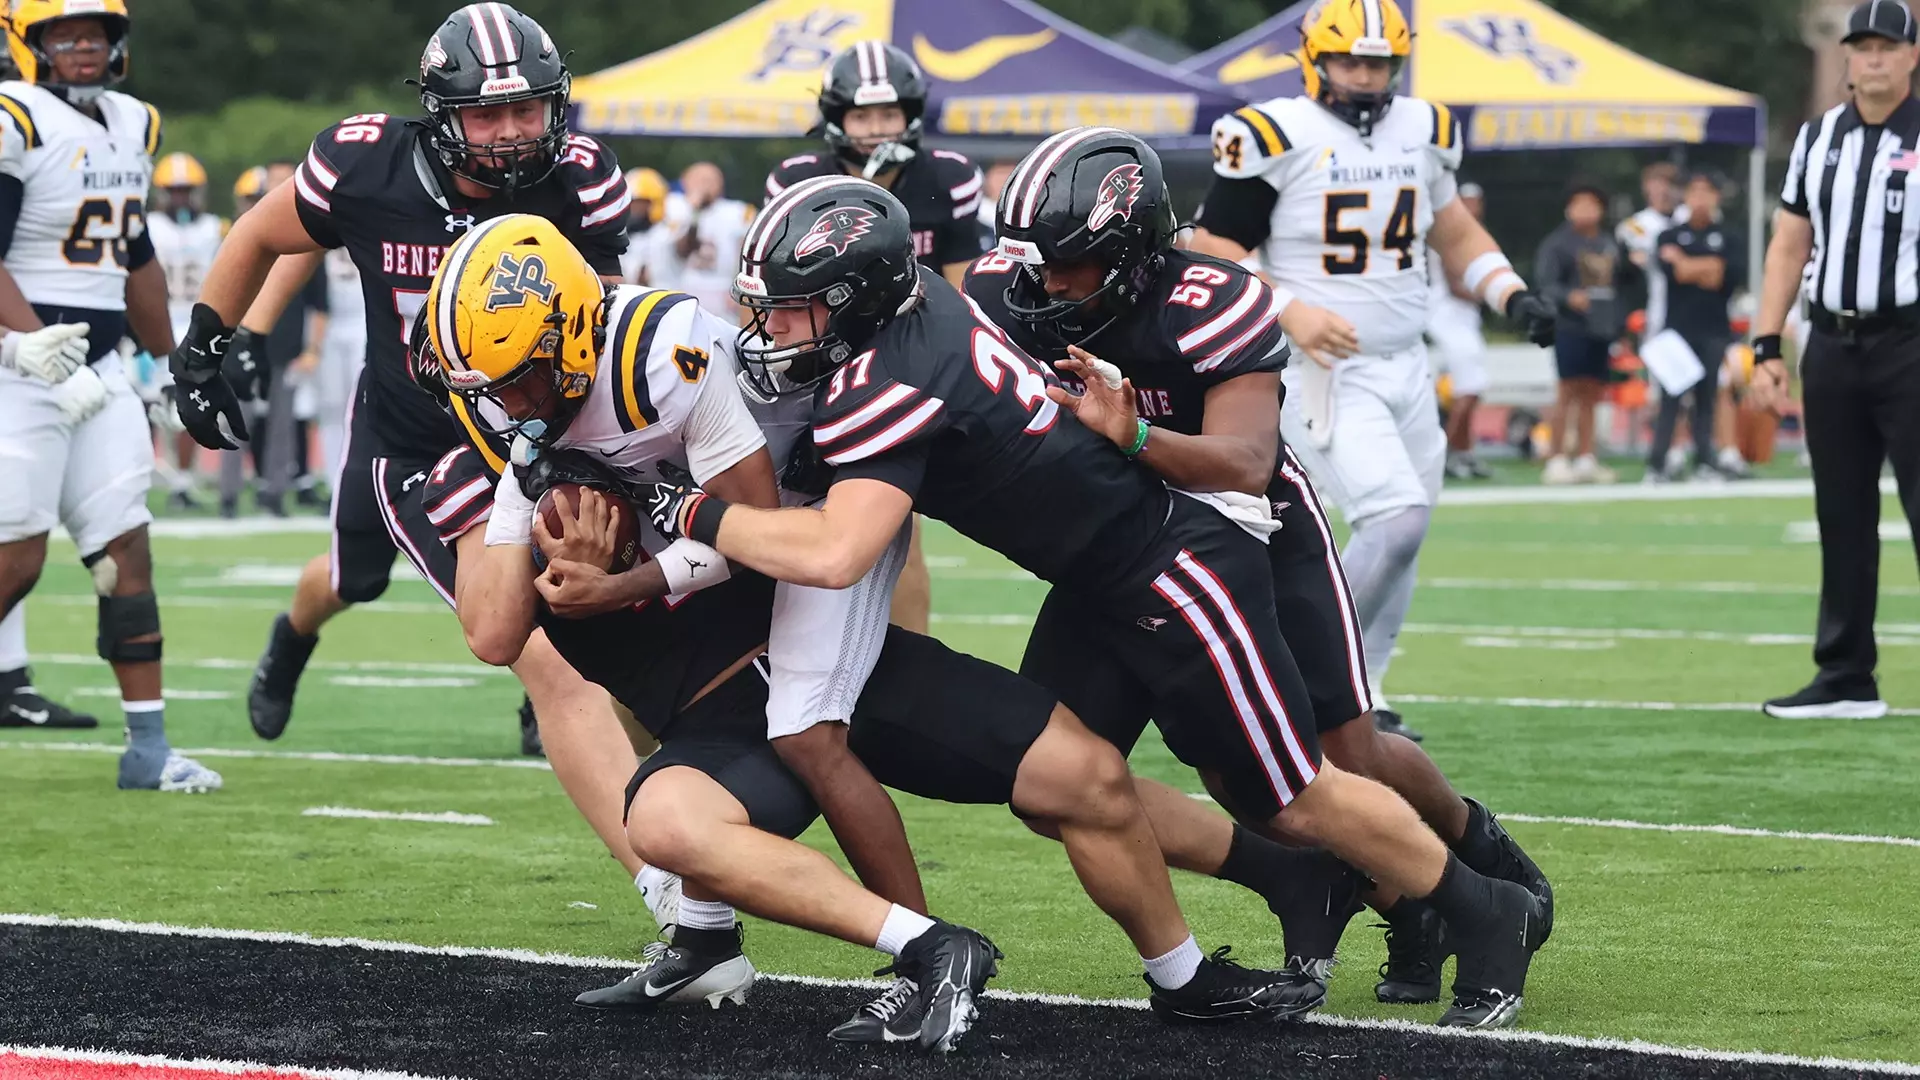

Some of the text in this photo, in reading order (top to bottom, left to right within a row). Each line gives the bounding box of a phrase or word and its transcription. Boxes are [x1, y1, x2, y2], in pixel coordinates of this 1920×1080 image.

[334, 113, 390, 144] 56
[1886, 188, 1904, 214] U
[1322, 185, 1417, 277] 54
[381, 241, 451, 279] BENE
[484, 251, 557, 314] WP
[1165, 264, 1233, 309] 59
[671, 344, 710, 385] 4
[825, 349, 877, 406] 37
